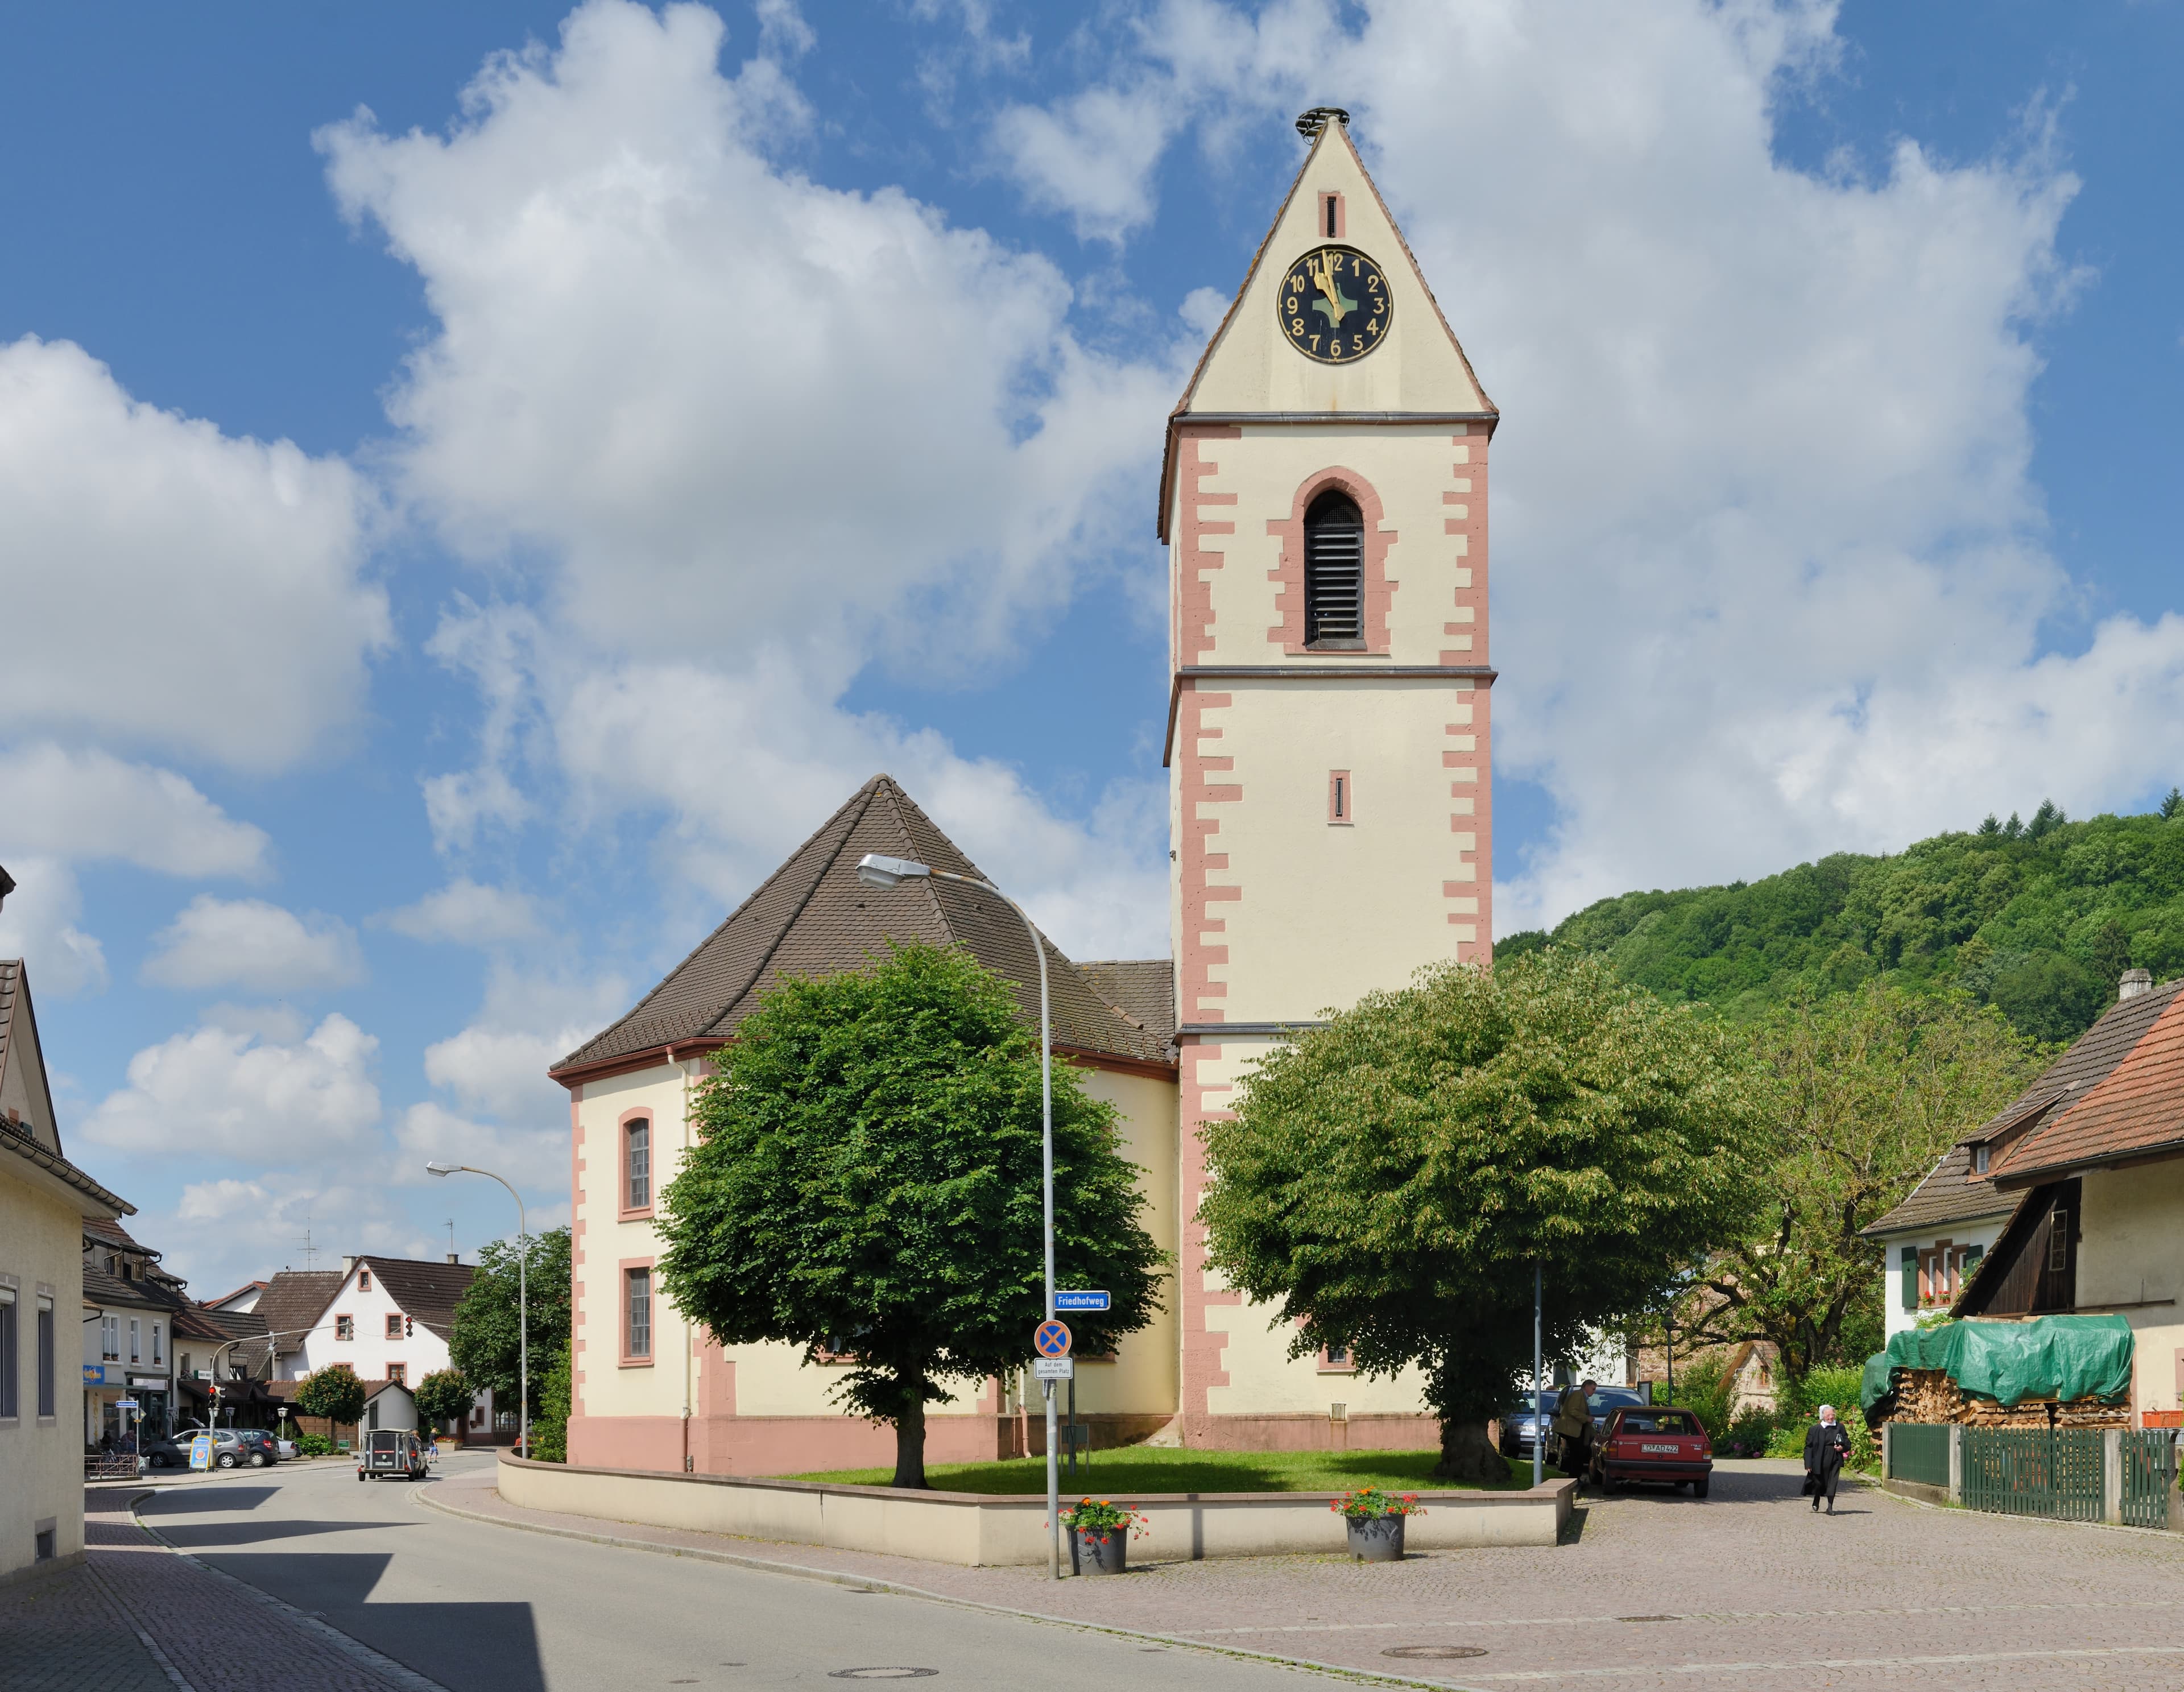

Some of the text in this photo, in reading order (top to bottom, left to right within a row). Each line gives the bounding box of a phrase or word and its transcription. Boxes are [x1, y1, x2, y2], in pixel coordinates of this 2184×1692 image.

[1306, 259, 1319, 276] 11
[1327, 253, 1343, 271] 12
[1352, 259, 1360, 276] 1
[1290, 275, 1305, 293] 10
[1367, 275, 1379, 292] 2
[1287, 296, 1298, 315] 9
[1373, 297, 1384, 314] 3
[1292, 318, 1304, 336] 8
[1366, 318, 1379, 336] 4
[1309, 334, 1321, 351] 7
[1330, 340, 1341, 357] 6
[1352, 334, 1363, 351] 5
[1058, 1296, 1104, 1307] Friedhofweg
